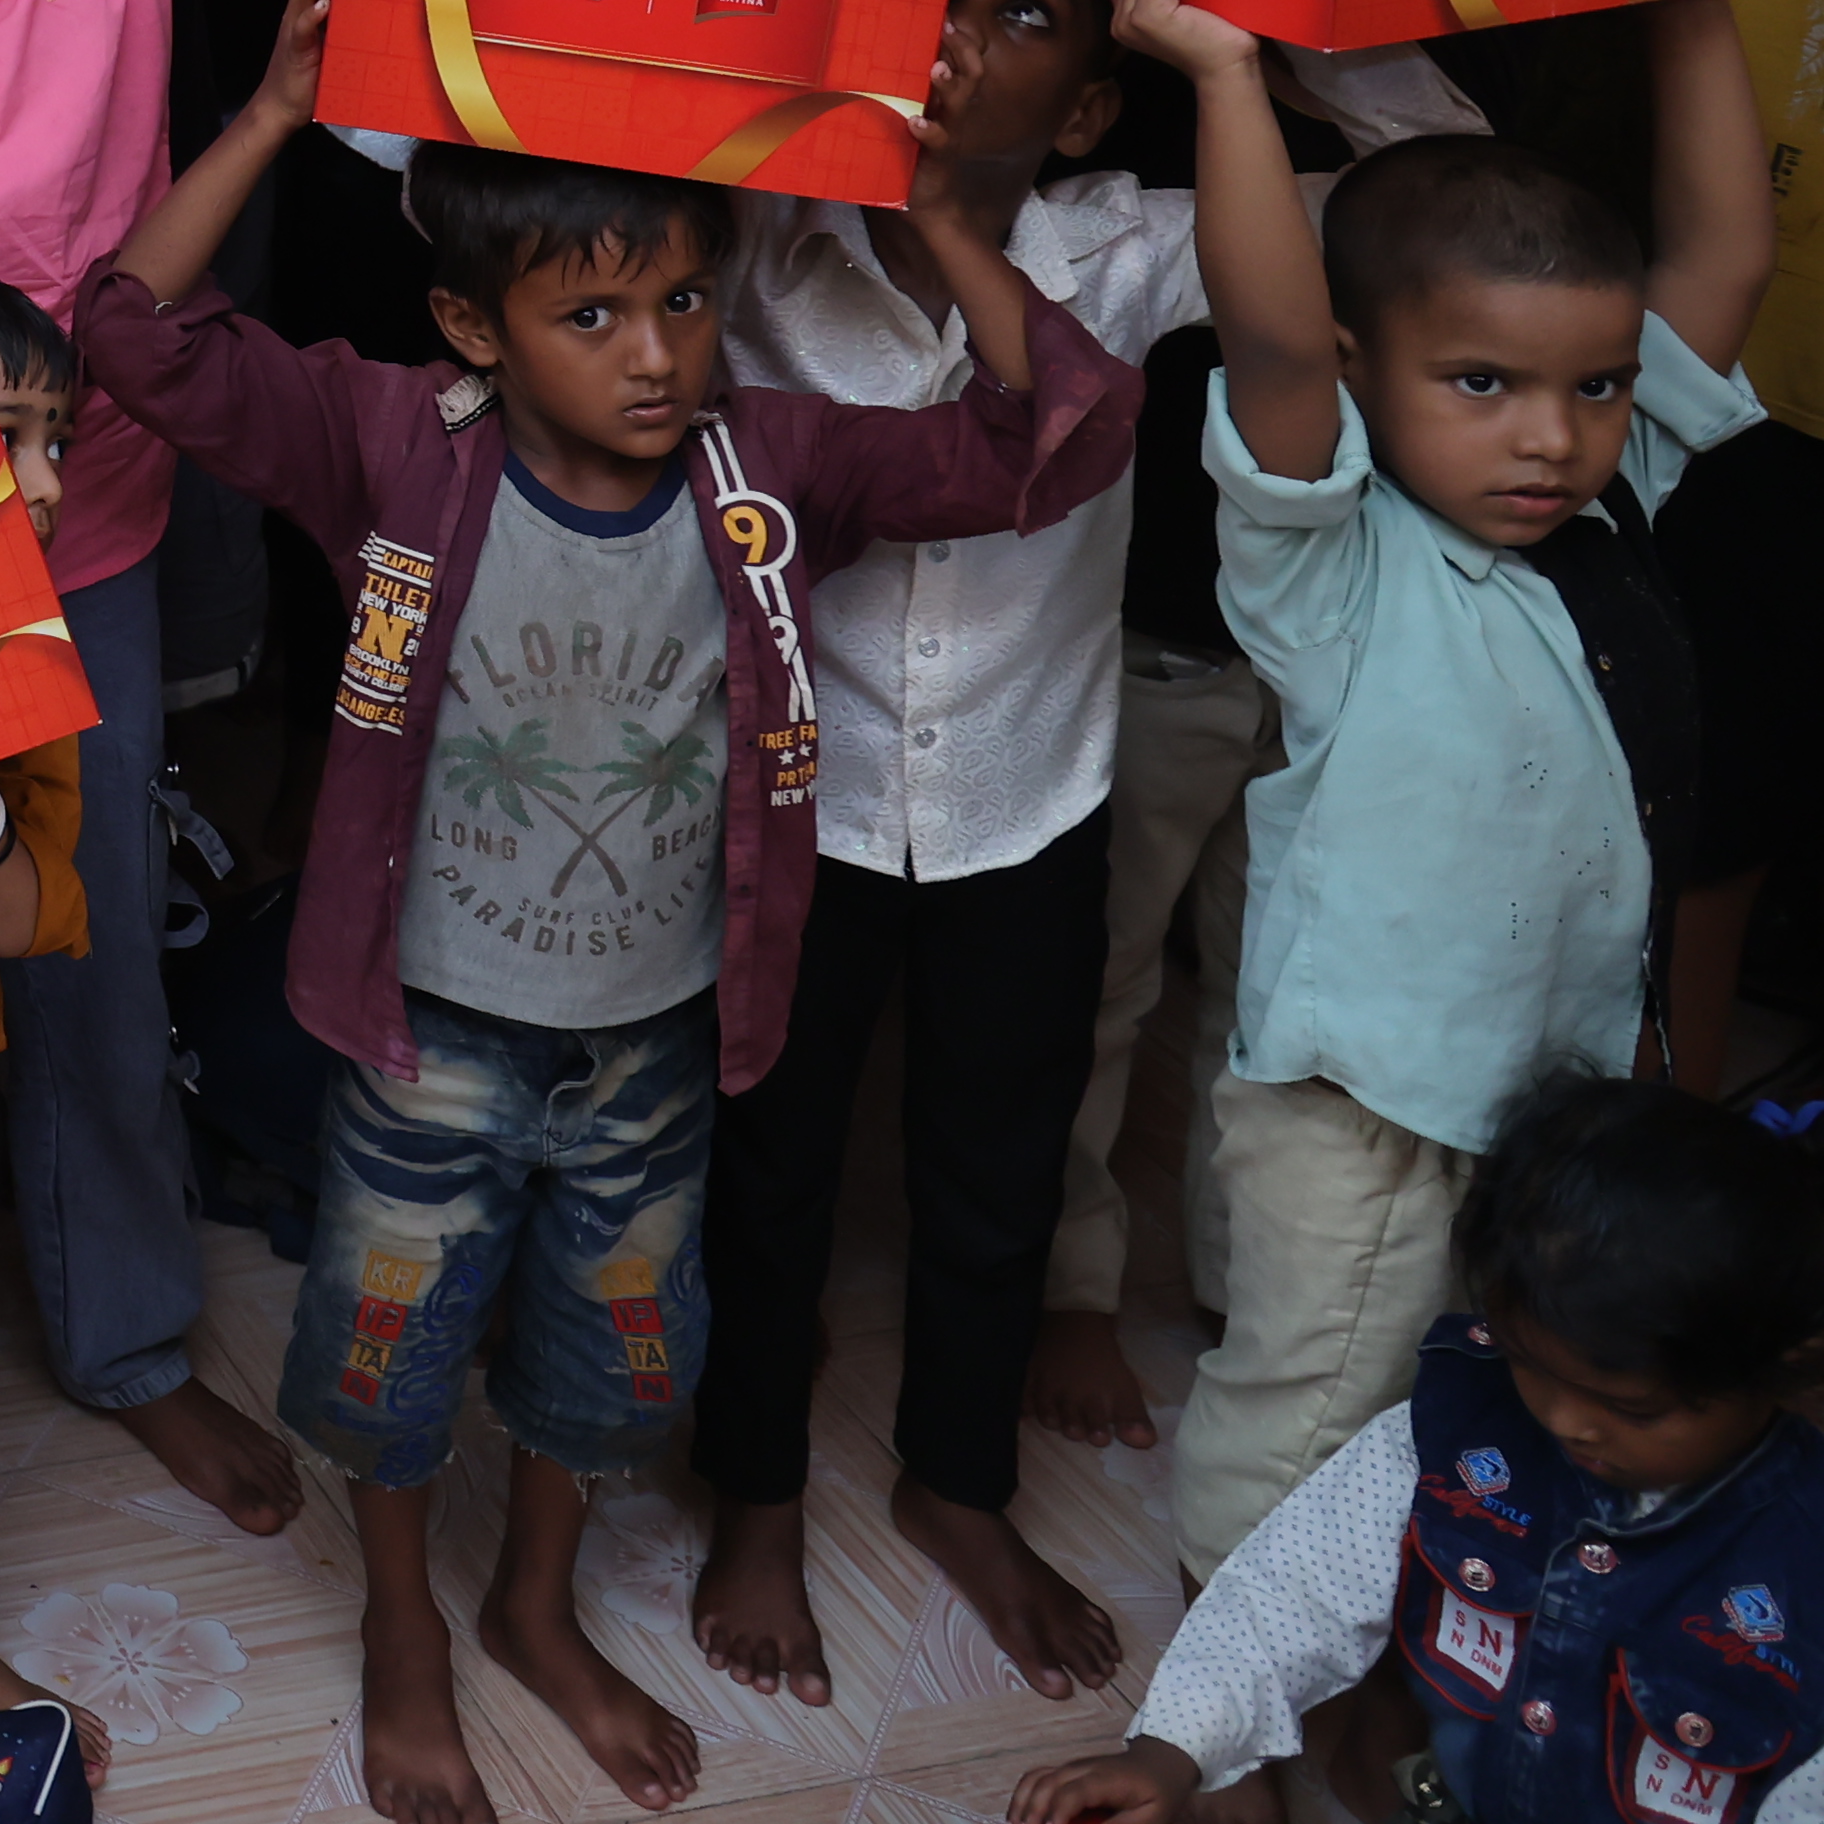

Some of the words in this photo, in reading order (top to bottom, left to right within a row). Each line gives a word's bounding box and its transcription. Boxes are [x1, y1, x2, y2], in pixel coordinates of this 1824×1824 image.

[722, 505, 768, 564] 9
[360, 589, 388, 610] NEW
[357, 606, 414, 663] N
[349, 643, 410, 676] BROOKLYN
[444, 620, 725, 705] FLORIDA
[770, 788, 805, 807] NEW
[430, 813, 518, 861] LONG
[432, 865, 634, 956] PARADISE
[518, 897, 575, 924] SURF
[592, 900, 646, 925] CLUB
[1481, 1495, 1532, 1526] STYLE
